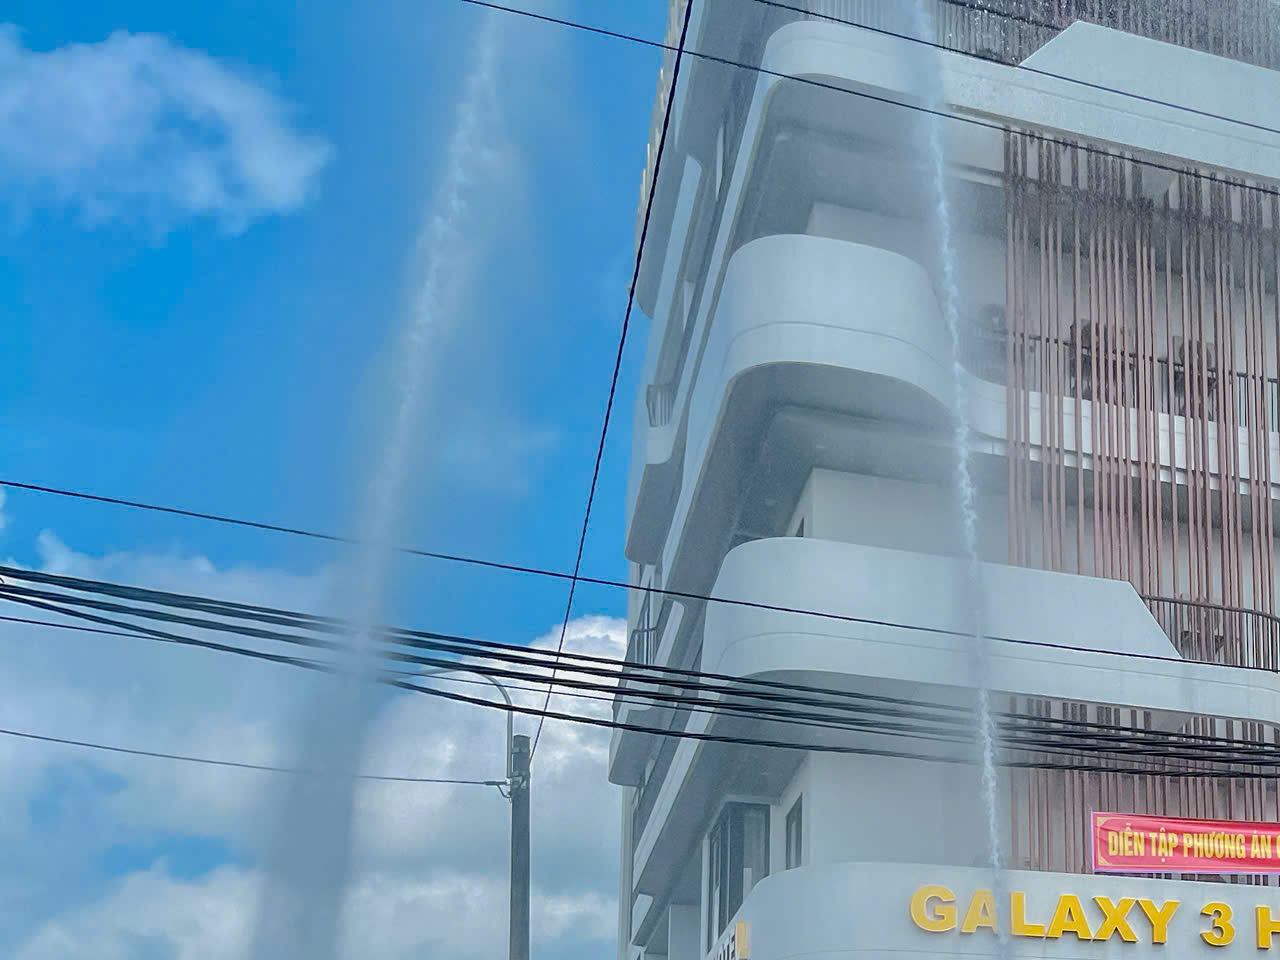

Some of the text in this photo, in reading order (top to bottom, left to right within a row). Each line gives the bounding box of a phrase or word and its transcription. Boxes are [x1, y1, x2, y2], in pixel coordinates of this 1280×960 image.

[1108, 822, 1145, 856] DIỄN
[1149, 827, 1178, 863] TẬP
[1183, 831, 1245, 859] PHƯƠNG
[1250, 829, 1272, 859] ÁN
[909, 885, 1180, 944] GALAXY
[1200, 902, 1236, 947] 3
